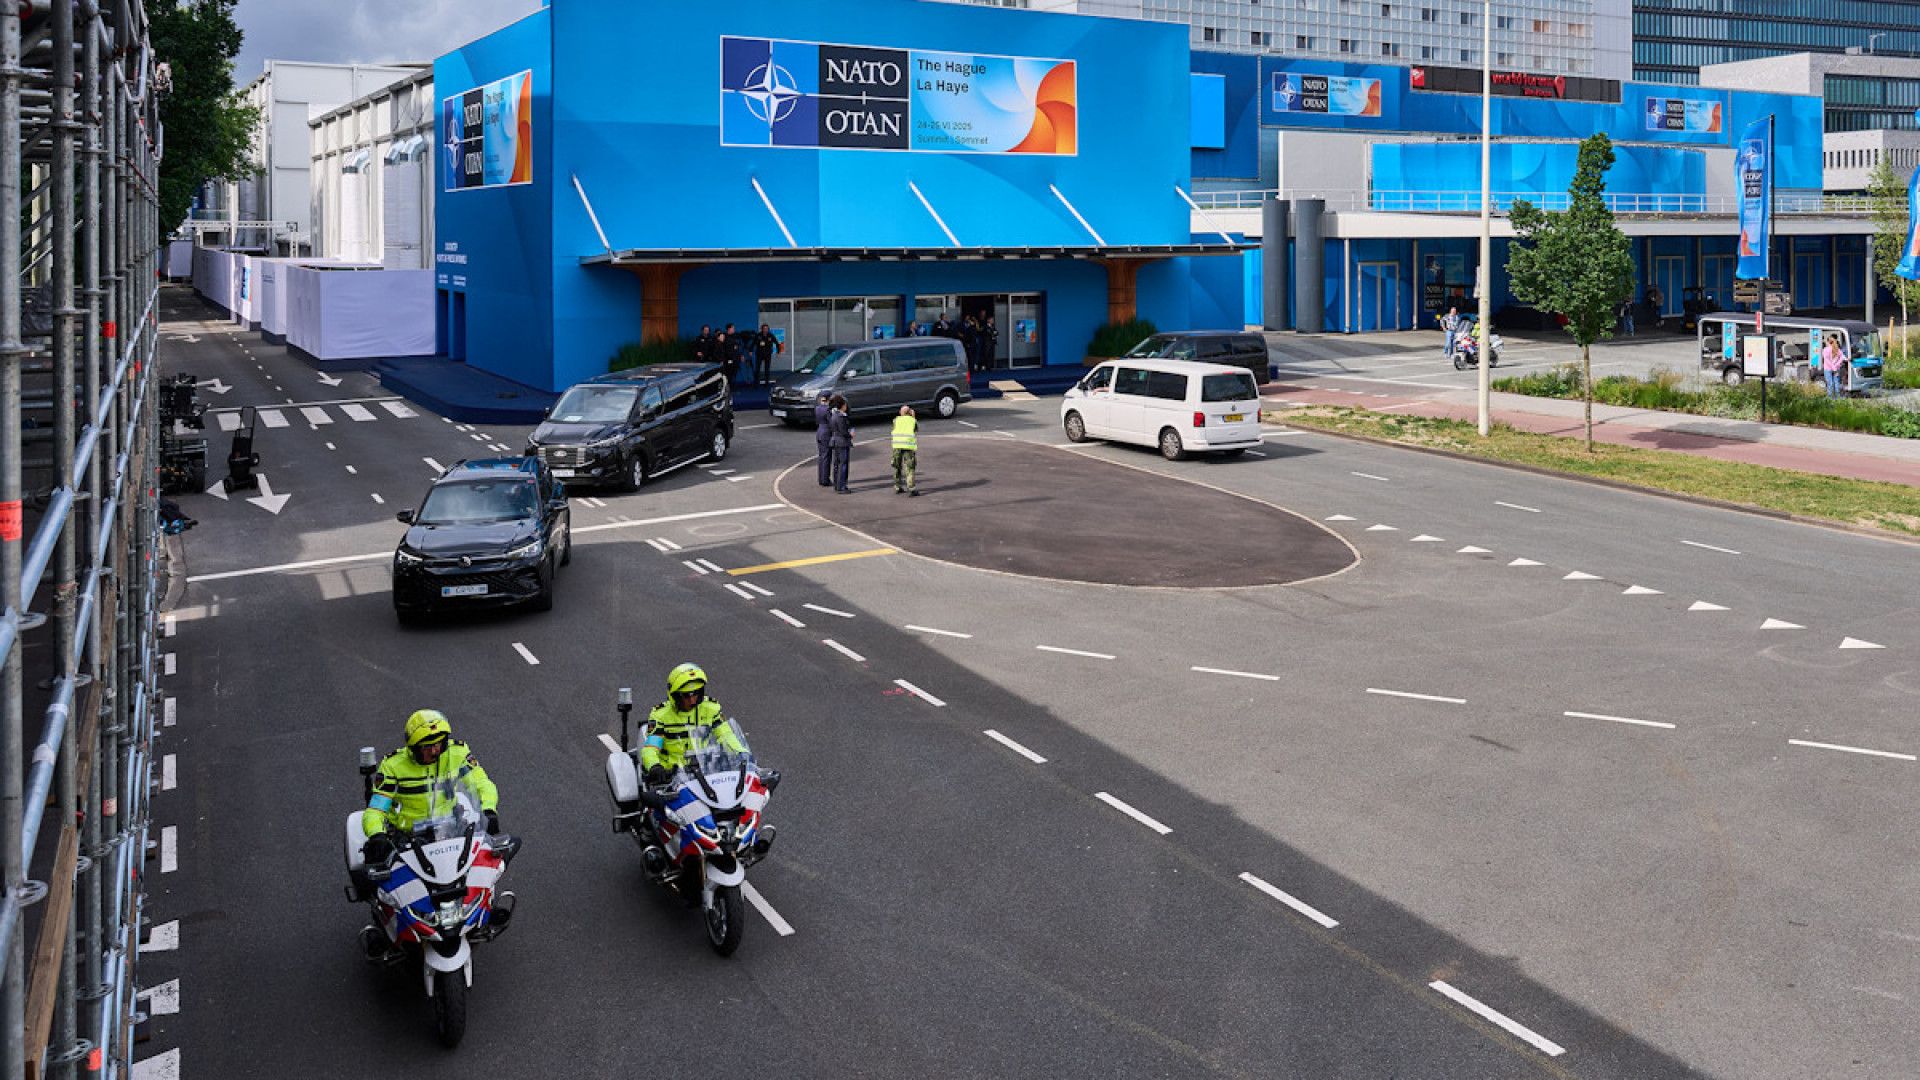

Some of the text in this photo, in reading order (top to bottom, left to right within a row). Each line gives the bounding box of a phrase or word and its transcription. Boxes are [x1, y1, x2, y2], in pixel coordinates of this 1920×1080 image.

[826, 59, 901, 86] NATO
[917, 59, 986, 77] The Hague
[917, 79, 969, 96] La Haye
[1303, 80, 1327, 90] NATO
[1303, 98, 1327, 108] OTAN
[464, 102, 482, 127] NATO
[826, 110, 901, 137] OTAN
[917, 120, 940, 130] 24-25
[952, 122, 973, 131] 2025
[917, 135, 949, 145] Summit
[955, 136, 988, 146] Sommet
[465, 152, 482, 175] OTAN
[429, 845, 460, 856] POLITIE
